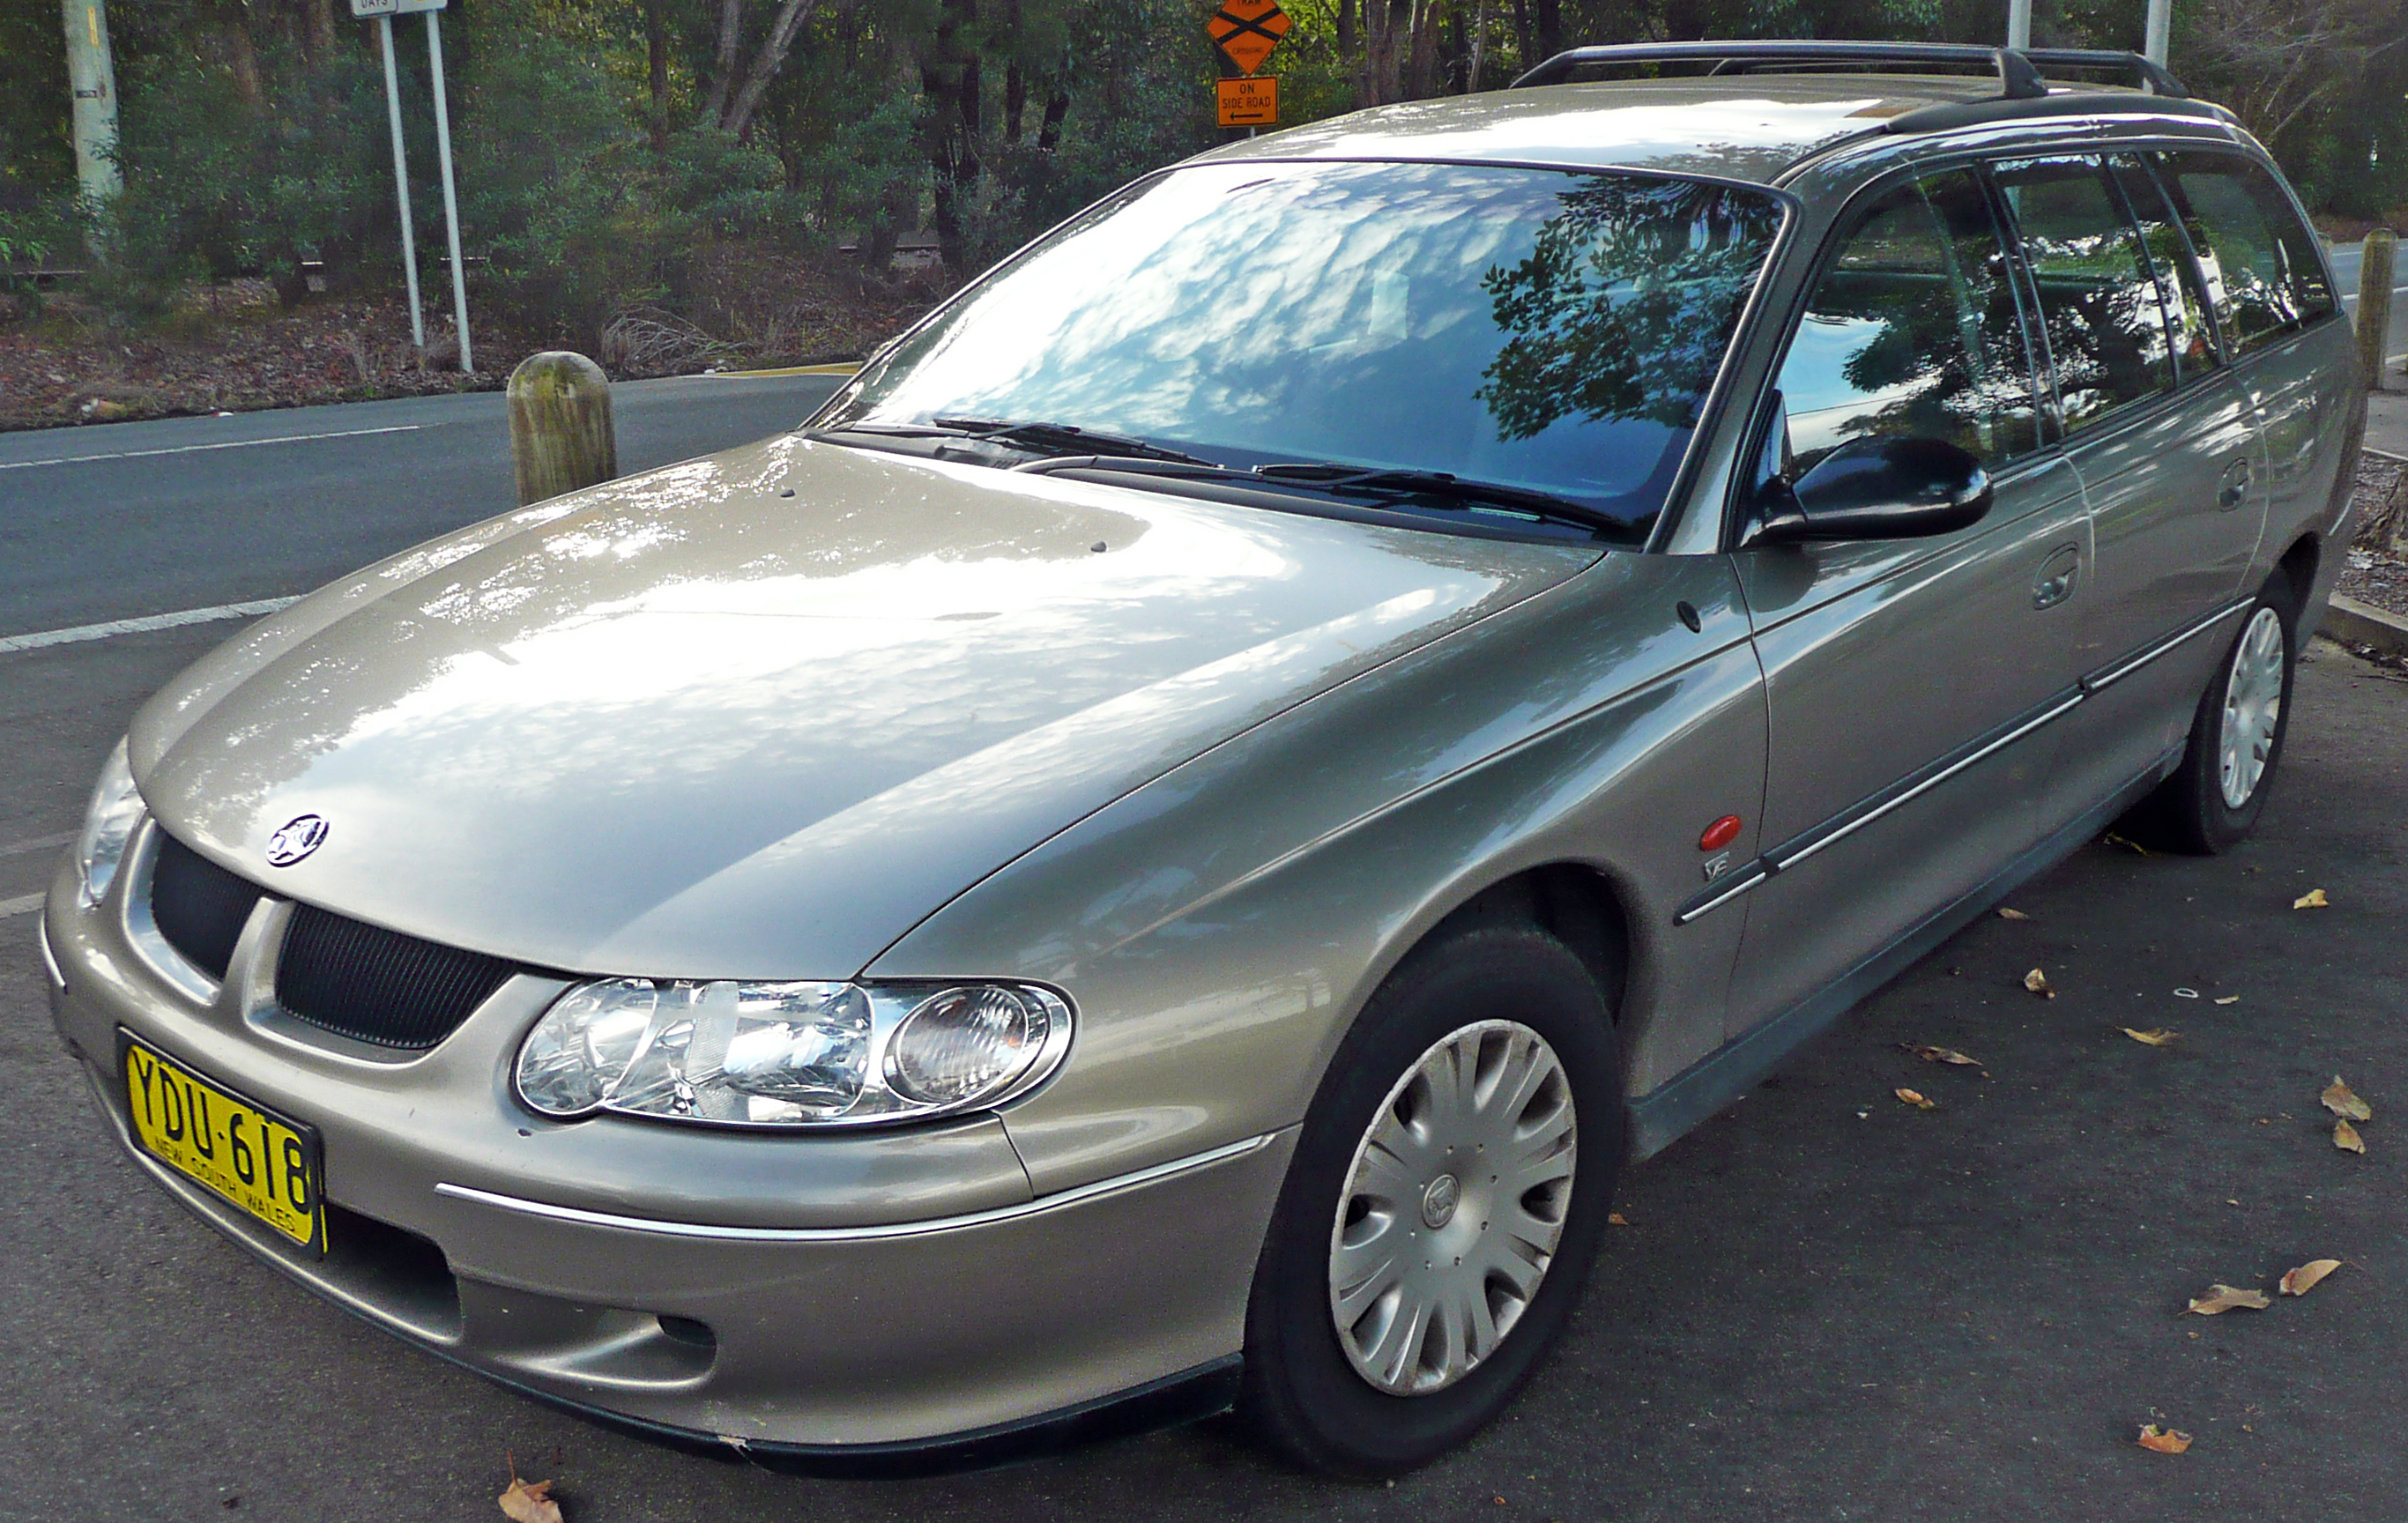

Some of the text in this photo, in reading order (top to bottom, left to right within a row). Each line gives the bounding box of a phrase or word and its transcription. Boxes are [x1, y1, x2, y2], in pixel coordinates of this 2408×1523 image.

[1239, 84, 1254, 94] ON
[1223, 96, 1271, 108] SIDE ROAD
[155, 1137, 296, 1232] NEW SOUTH WALES
